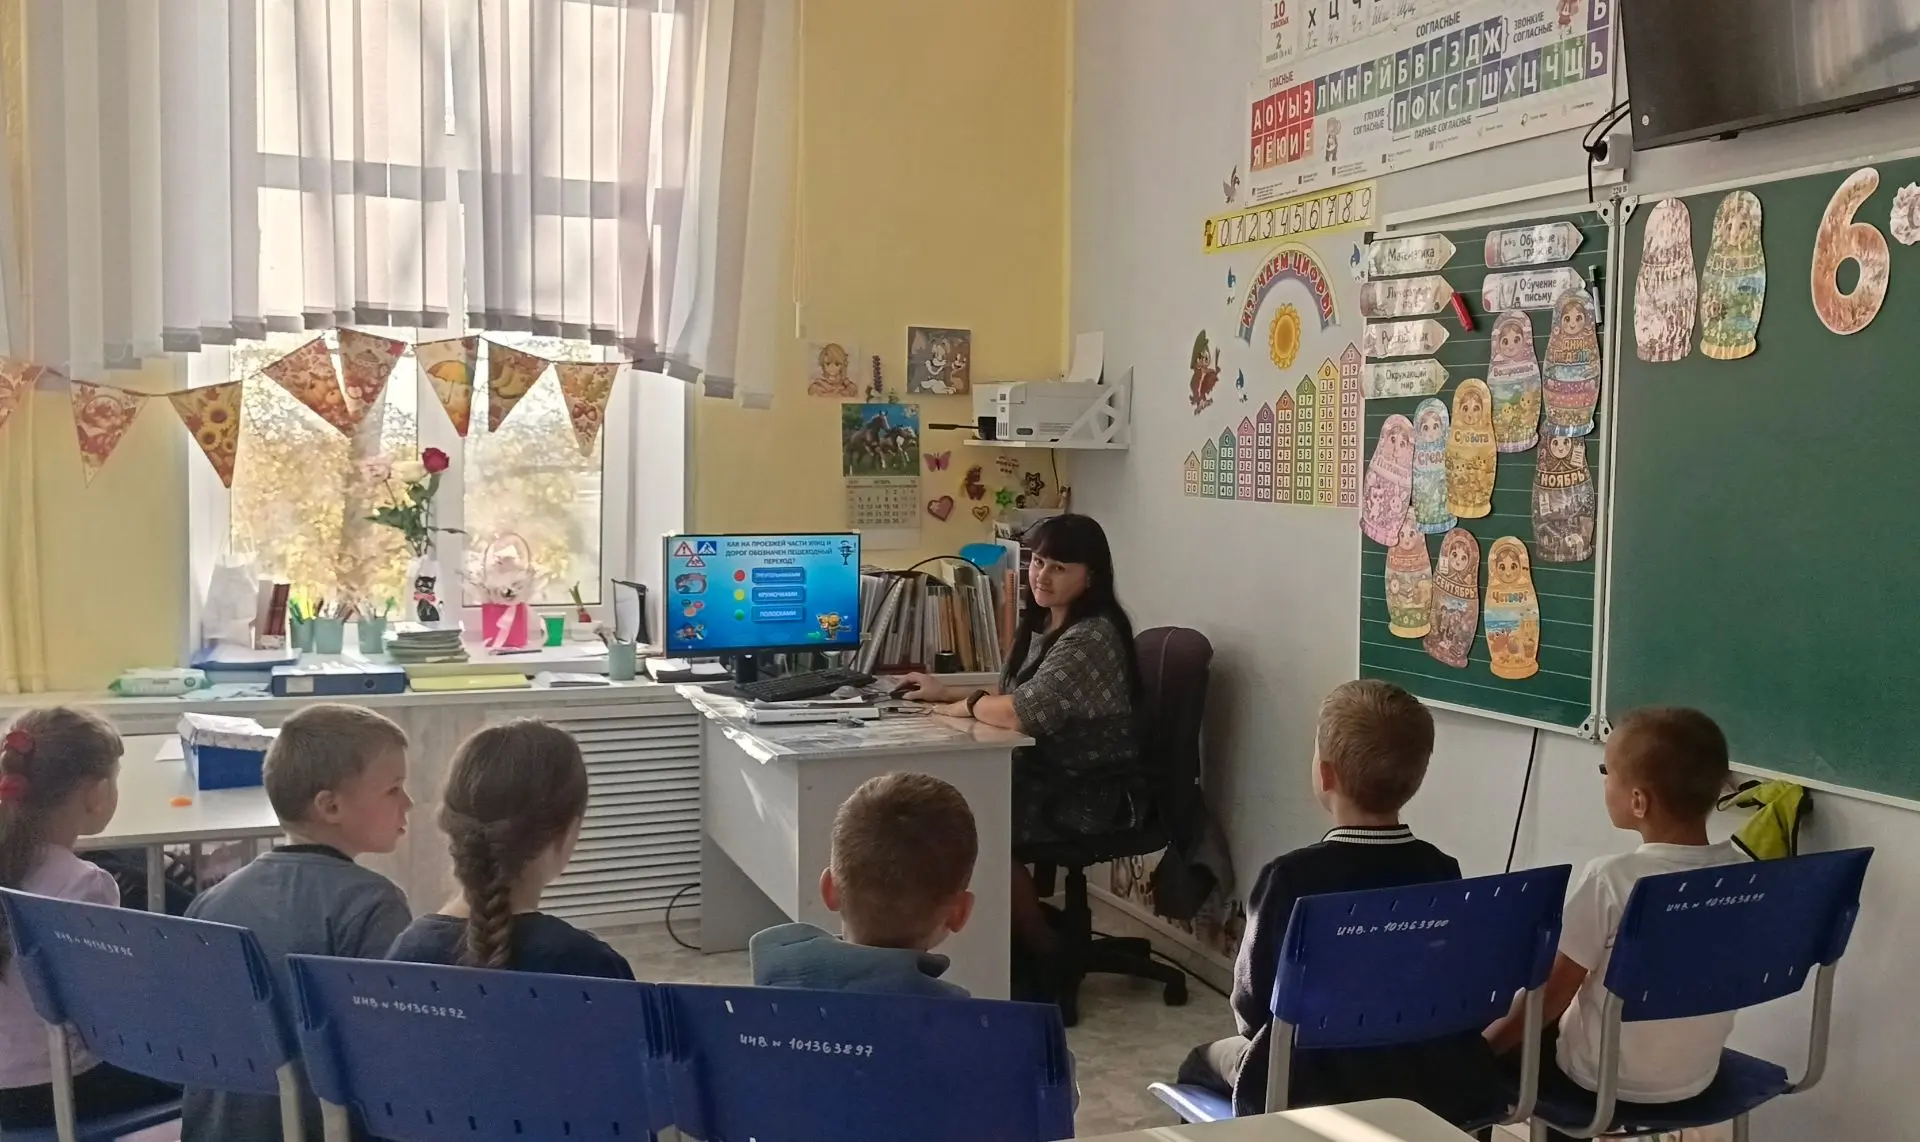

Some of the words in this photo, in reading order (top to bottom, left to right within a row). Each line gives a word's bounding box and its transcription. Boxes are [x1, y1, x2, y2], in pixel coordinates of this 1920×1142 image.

[1274, 0, 1286, 19] 10
[1308, 8, 1316, 28] Х
[1416, 11, 1460, 38] СОГЛАСНЫЕ
[1514, 11, 1544, 30] ЗВОНКИЕ
[1276, 32, 1281, 49] 2
[1513, 22, 1553, 43] СОГЛАСНЫЕ
[1269, 71, 1294, 89] ГЛАСНЫЕ
[1364, 108, 1385, 121] ГЛУХИЕ
[1353, 120, 1384, 136] СОГЛАСНЫЕ
[1414, 123, 1436, 140] ПАРНЫЕ
[1438, 115, 1472, 133] СОГЛАСНЫЕ
[1811, 167, 1890, 335] 6
[1242, 251, 1289, 328] ИЗУЧАЕМ
[1292, 252, 1333, 321] ЦИФРЫ
[1520, 278, 1556, 292] Обучение
[1525, 292, 1552, 302] письму
[1564, 338, 1584, 350] ДНИ
[1554, 350, 1589, 363] НЕДЕЛИ
[1386, 368, 1426, 380] Окружающий
[1401, 382, 1414, 390] мир
[1418, 452, 1445, 465] Сред
[1541, 470, 1585, 487] НОЯБРЬ
[1436, 576, 1475, 598] СЕНТЯБРЬ
[393, 1001, 466, 1018] 101363892
[789, 1038, 873, 1056] 101363897
